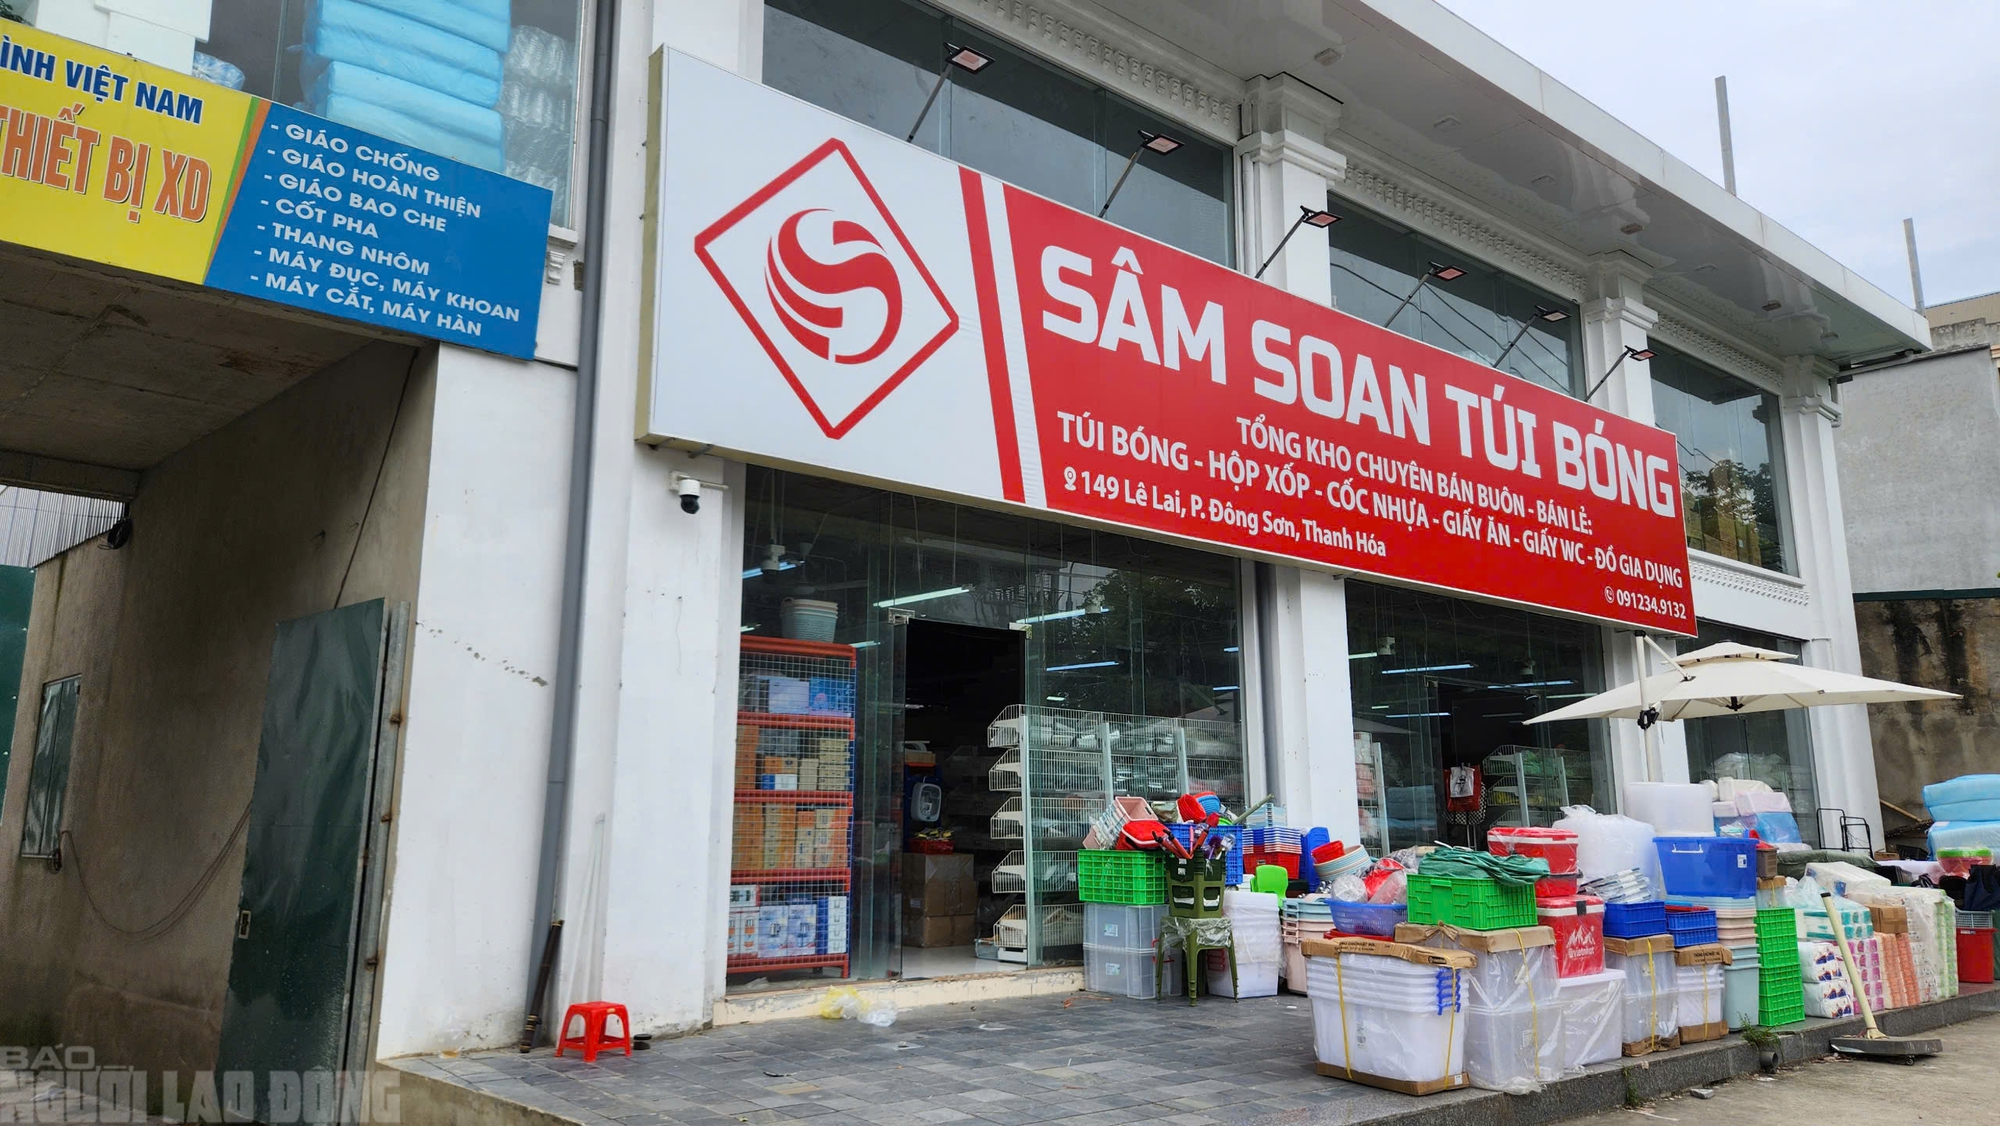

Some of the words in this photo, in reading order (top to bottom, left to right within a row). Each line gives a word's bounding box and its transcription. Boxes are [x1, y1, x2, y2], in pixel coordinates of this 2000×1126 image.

[66, 60, 128, 103] VIỆT
[135, 82, 203, 124] NAM
[103, 135, 151, 223] BỊ
[153, 149, 212, 223] XD
[282, 148, 345, 178] GIÁO
[352, 169, 417, 200] HOÀN
[424, 189, 481, 218] THIỆN
[285, 123, 349, 153] GIÁO
[355, 145, 440, 181] CHỐNG
[275, 198, 327, 223] CỐT
[332, 213, 379, 238] PHA
[279, 173, 342, 202] GIÁO
[349, 192, 397, 217] BAO
[403, 208, 447, 232] CHE
[272, 221, 354, 256] THANG
[360, 246, 430, 275] NHÔM
[265, 272, 320, 298] MÁY
[325, 285, 375, 314] CẮT,
[382, 299, 431, 324] MÁY
[437, 313, 482, 336] HÀN
[268, 247, 323, 273] MÁY
[329, 262, 385, 291] ĐỤC,
[392, 278, 441, 301] MÁY
[446, 291, 520, 322] KHOAN
[1041, 245, 1227, 385] SÂM
[1251, 319, 1430, 446] SOAN
[1445, 383, 1541, 479] TÚI
[1553, 418, 1675, 518] BÓNG
[1057, 410, 1104, 451] TÚI
[1112, 425, 1188, 471] BÓNG
[1208, 450, 1260, 492] HỘP
[1265, 462, 1310, 499] XỐP
[1327, 478, 1369, 515] CỐC
[1372, 491, 1430, 532] NHỰA
[1443, 508, 1482, 541] GIẤY
[1487, 515, 1511, 547] ĂN
[1522, 528, 1558, 558] GIẤY
[1560, 537, 1585, 565] WC
[1595, 545, 1617, 572] ĐỒ
[1619, 554, 1643, 579] GIA
[1645, 559, 1683, 589] DỤNG
[1236, 414, 1301, 459] TỔNG
[1306, 436, 1351, 472] KHO
[1356, 451, 1433, 494] CHUYÊN
[1437, 471, 1474, 505] BÁN
[1477, 484, 1525, 518] BUÔN
[1537, 499, 1569, 530] BÁN
[1081, 471, 1119, 500] 149
[1124, 479, 1148, 507] Lê
[1152, 485, 1187, 518] Lai,
[1190, 494, 1205, 519] P.
[1209, 498, 1258, 535] Đông
[1262, 510, 1300, 542] Sơn,
[1302, 519, 1353, 550] Thanh
[1356, 531, 1386, 556] Hóa
[1617, 588, 1686, 619] 091234.9132
